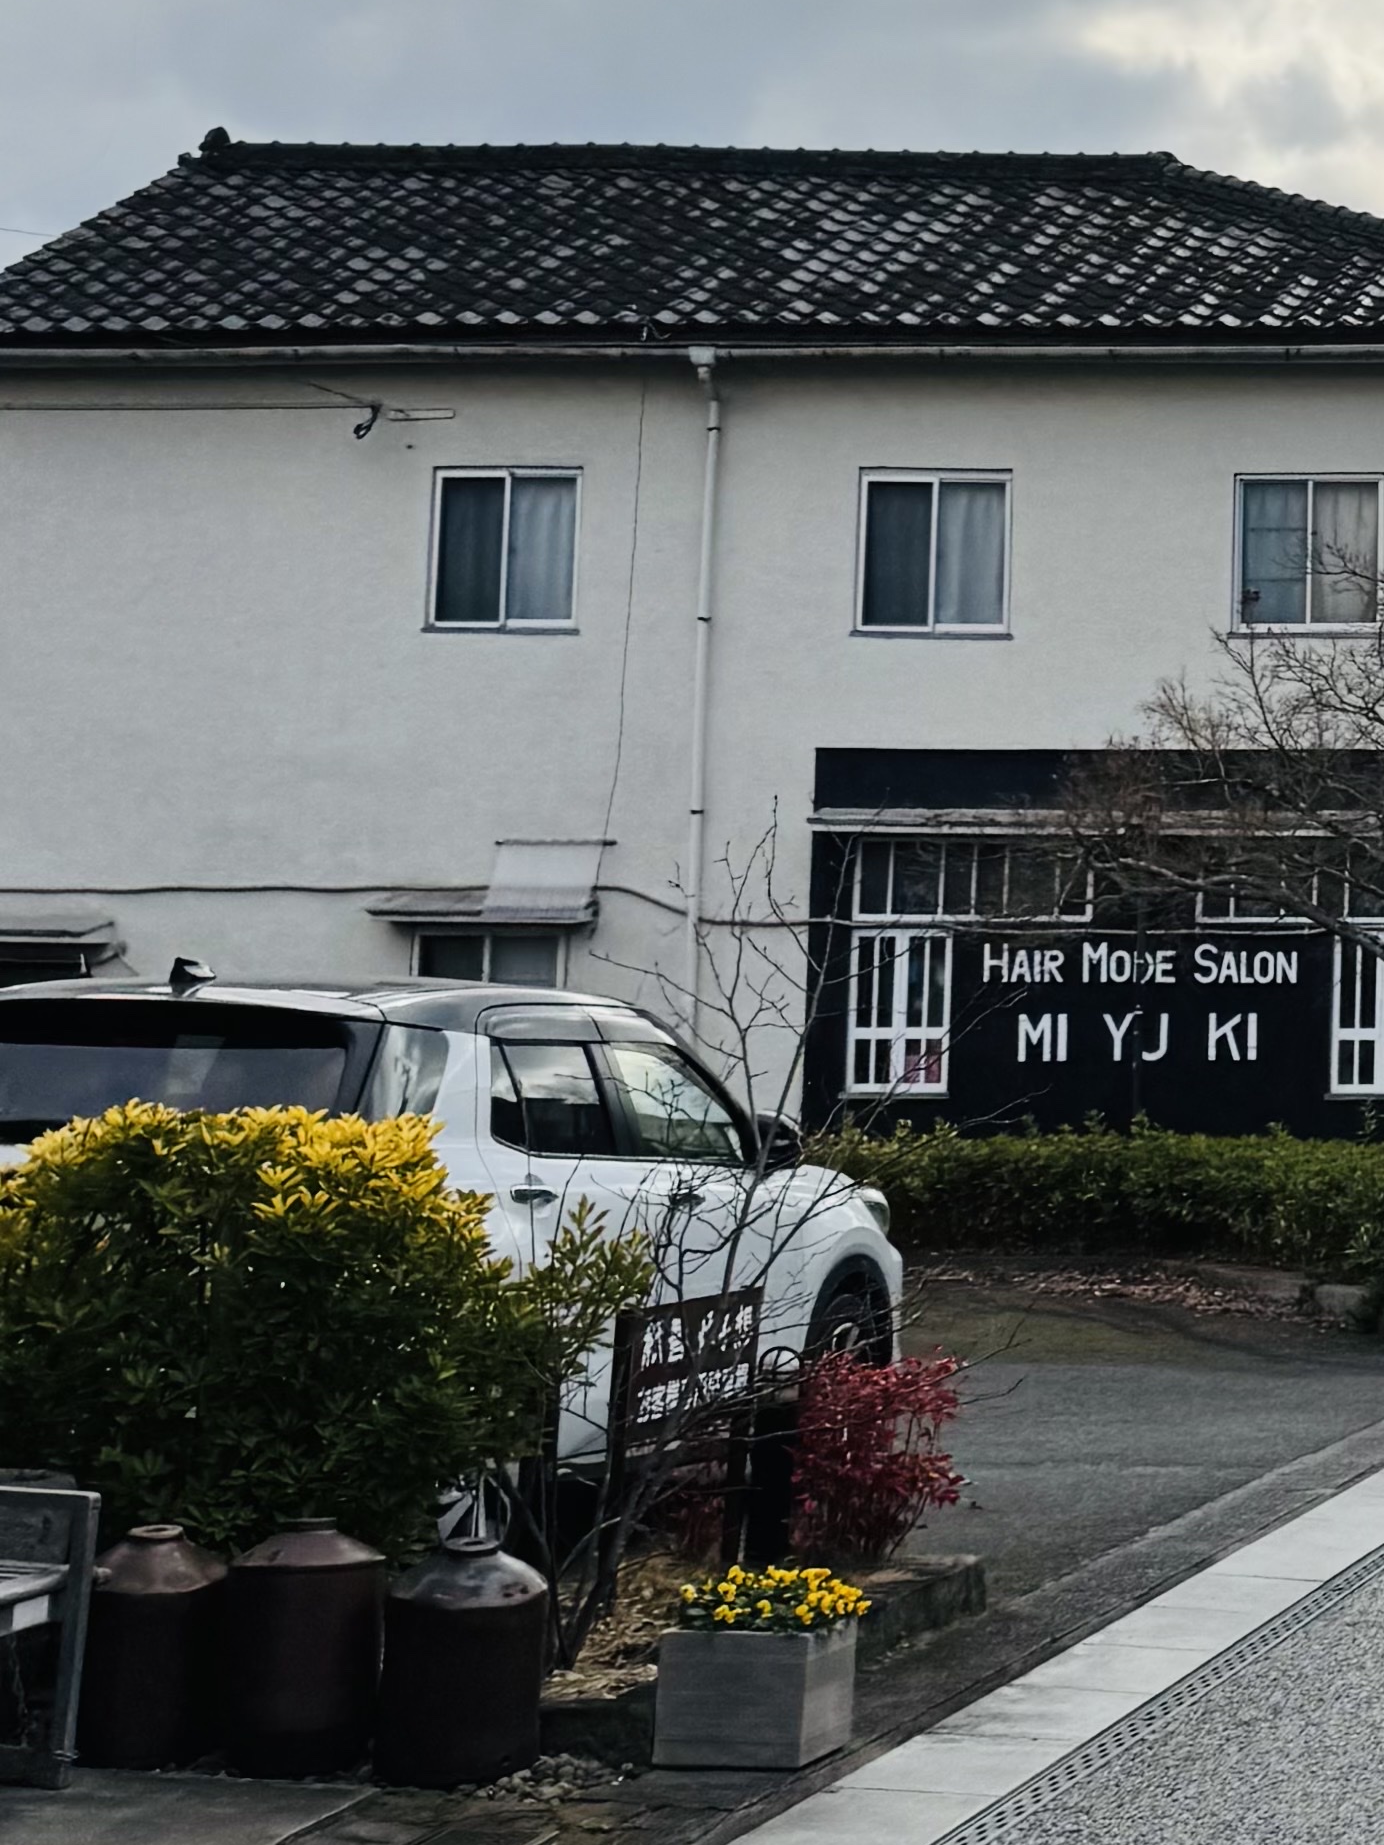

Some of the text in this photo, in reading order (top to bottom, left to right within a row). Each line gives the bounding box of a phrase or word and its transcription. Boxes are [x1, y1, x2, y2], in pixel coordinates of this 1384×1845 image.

[982, 942, 1065, 983] HAIR
[1193, 943, 1298, 984] SALON
[1017, 1013, 1068, 1062] MI
[1207, 1012, 1258, 1061] KI
